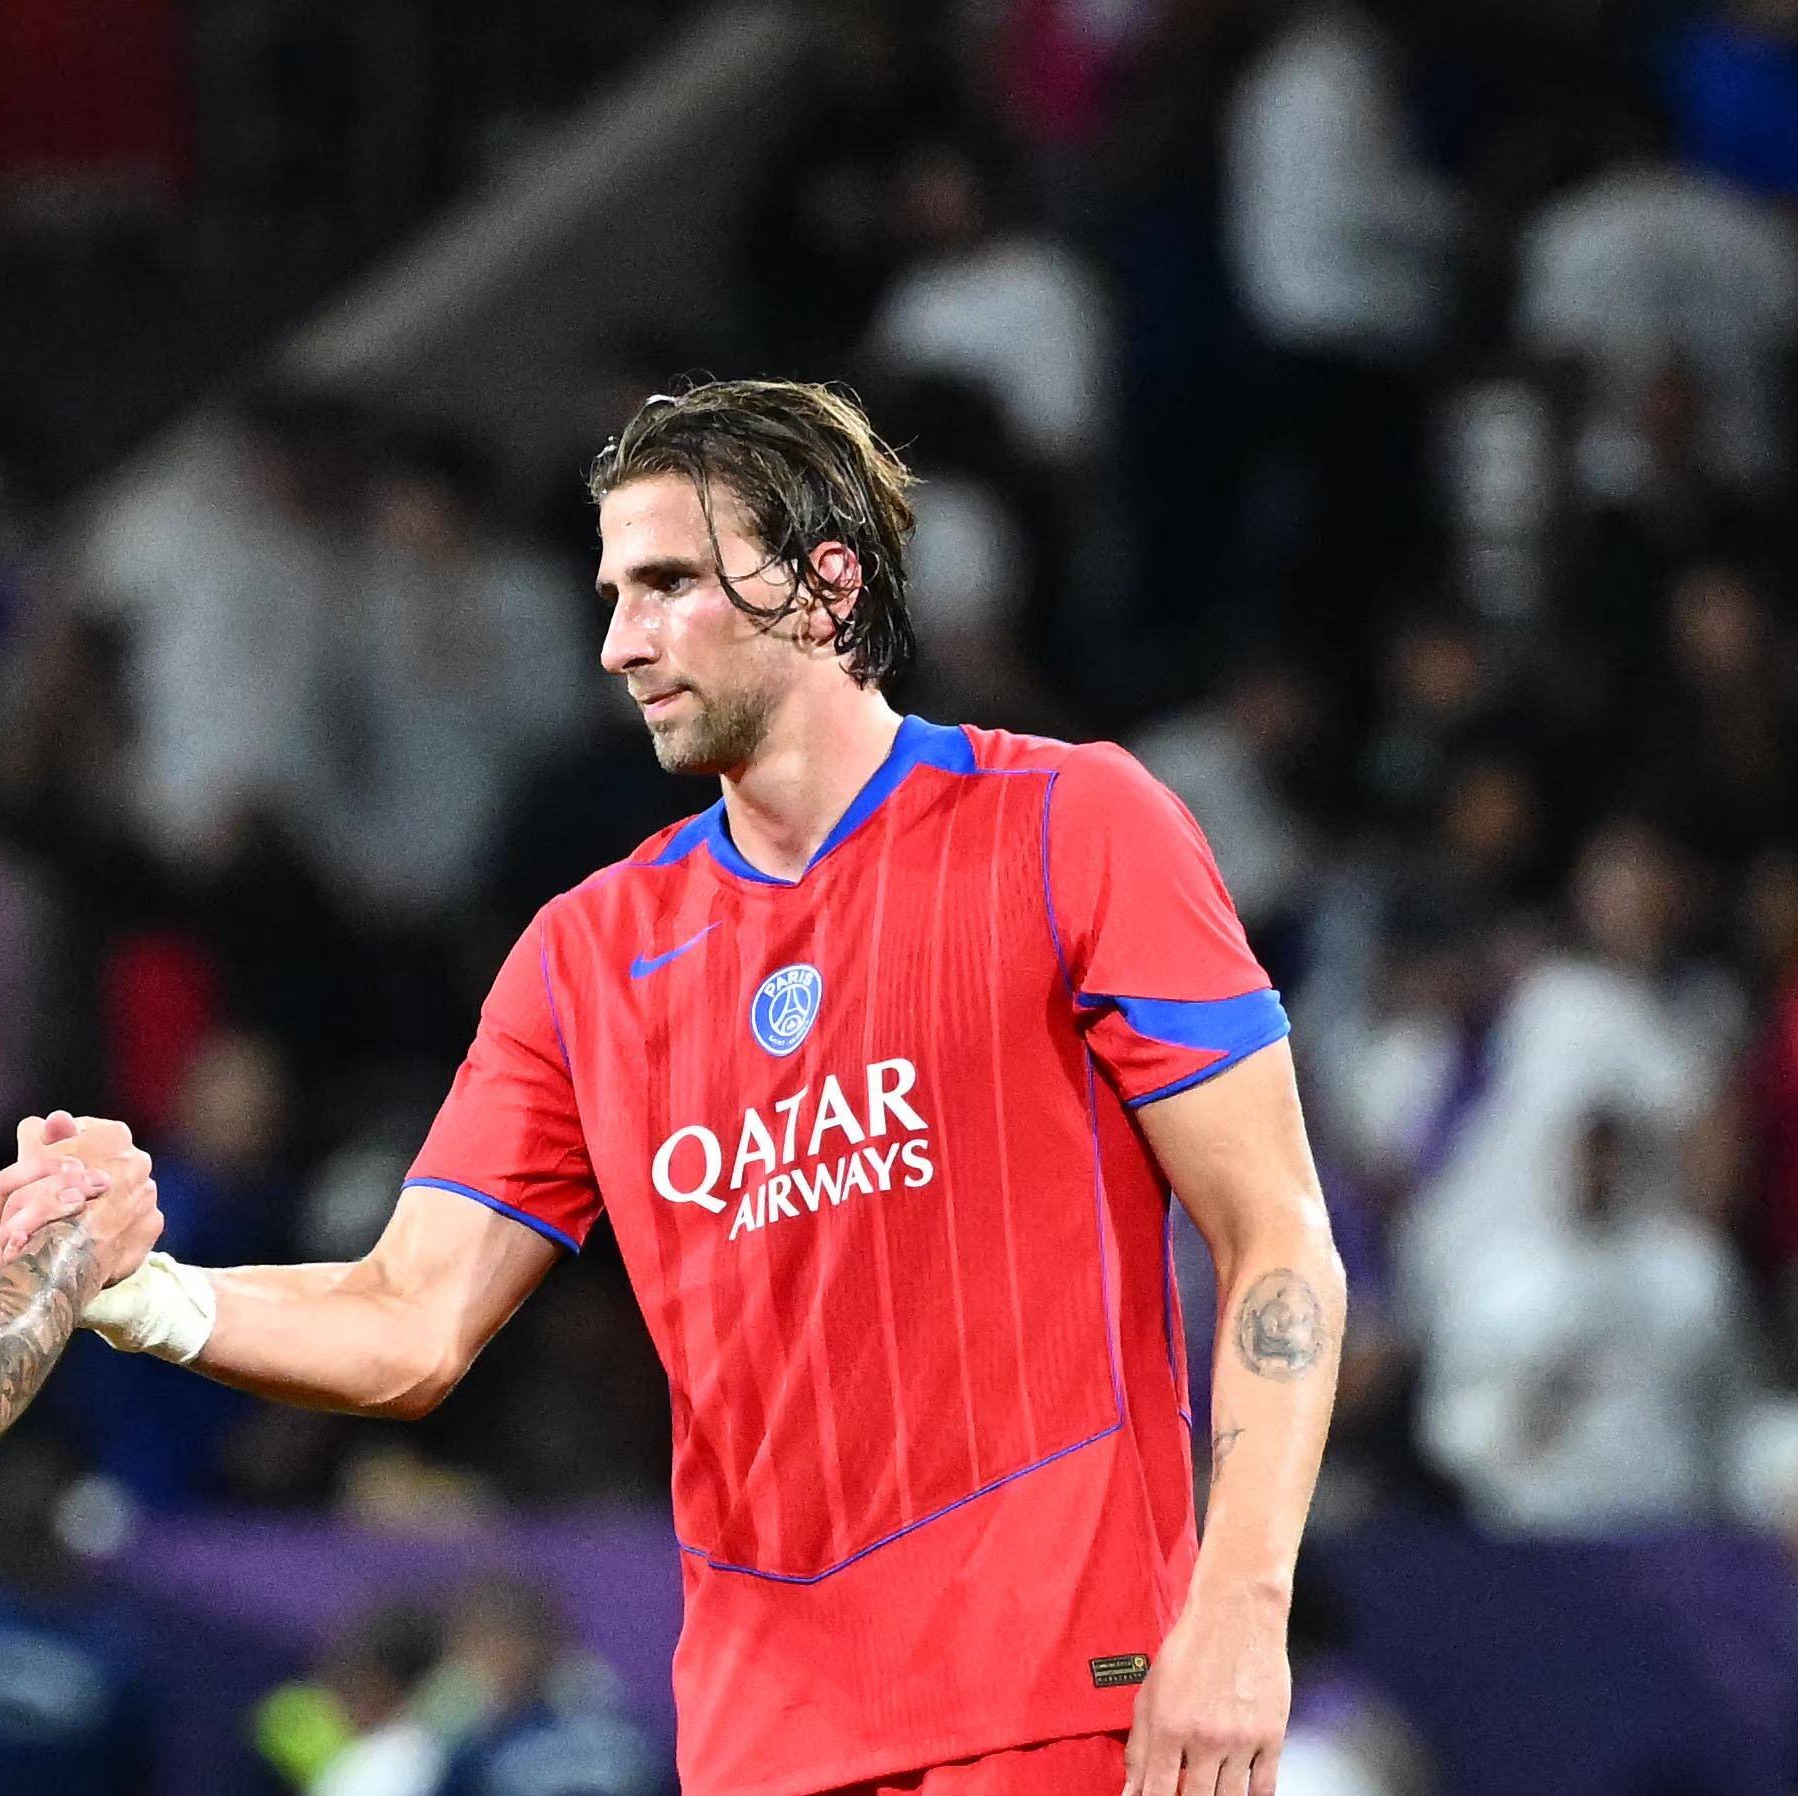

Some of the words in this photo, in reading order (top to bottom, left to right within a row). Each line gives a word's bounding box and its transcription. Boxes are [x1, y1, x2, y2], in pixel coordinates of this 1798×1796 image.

[763, 970, 815, 998] PARIS
[651, 1057, 929, 1214] QATAR
[728, 1138, 934, 1241] AIRWAYS
